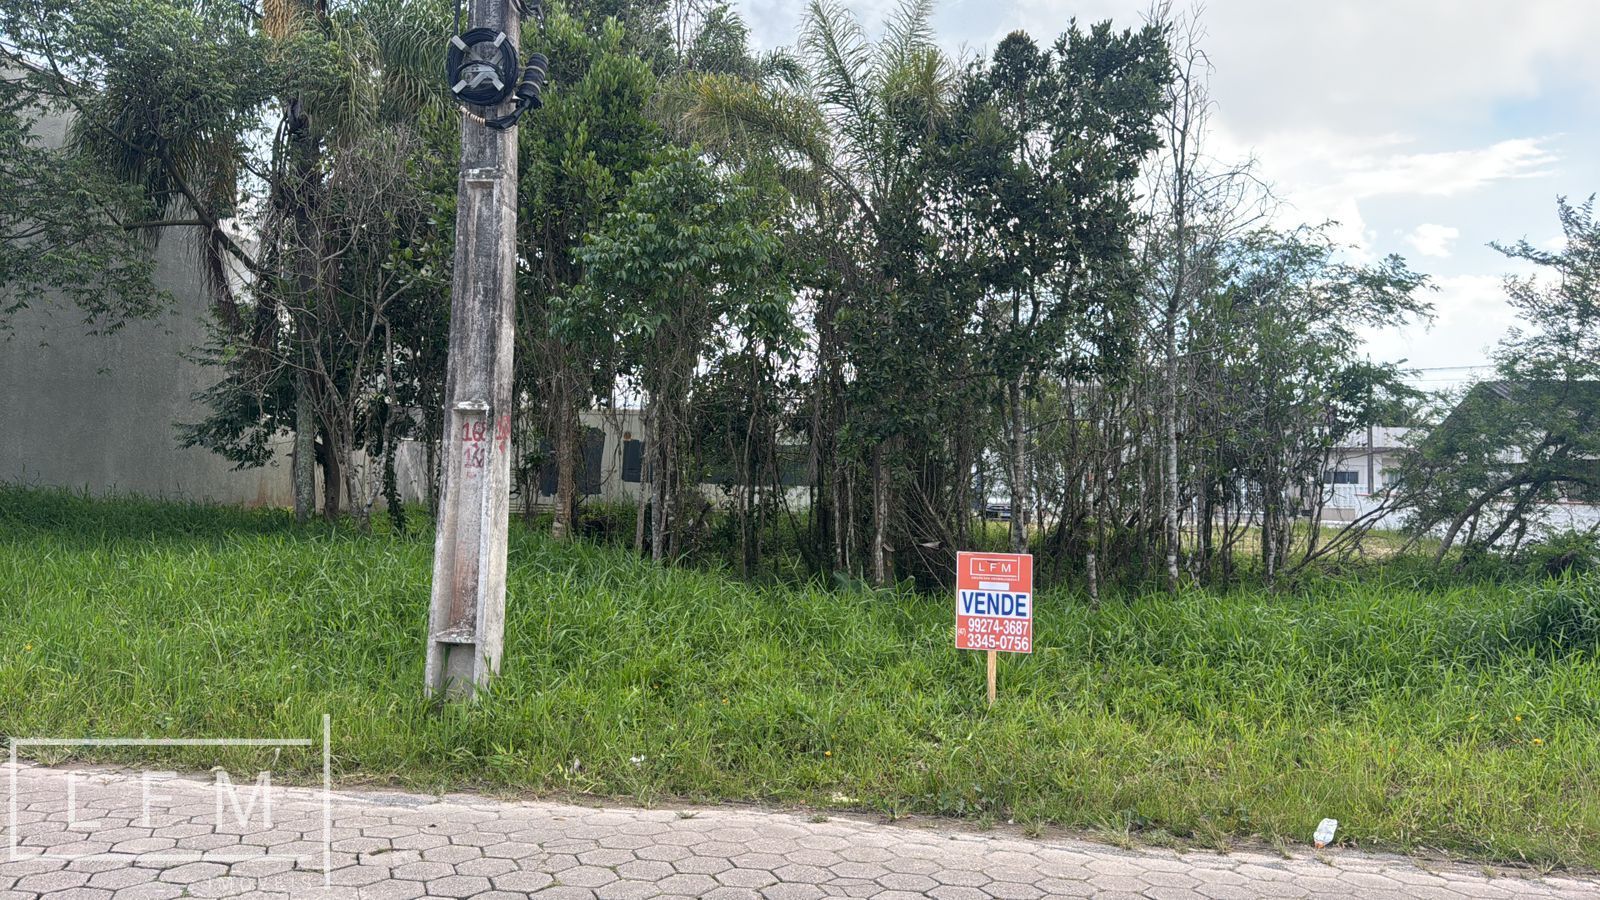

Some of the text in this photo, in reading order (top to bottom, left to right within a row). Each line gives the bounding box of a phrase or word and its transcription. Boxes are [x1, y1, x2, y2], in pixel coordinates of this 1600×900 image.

[962, 591, 1027, 617] VENDE
[968, 618, 1029, 635] 99274-3687
[967, 633, 1029, 651] 3345-0756
